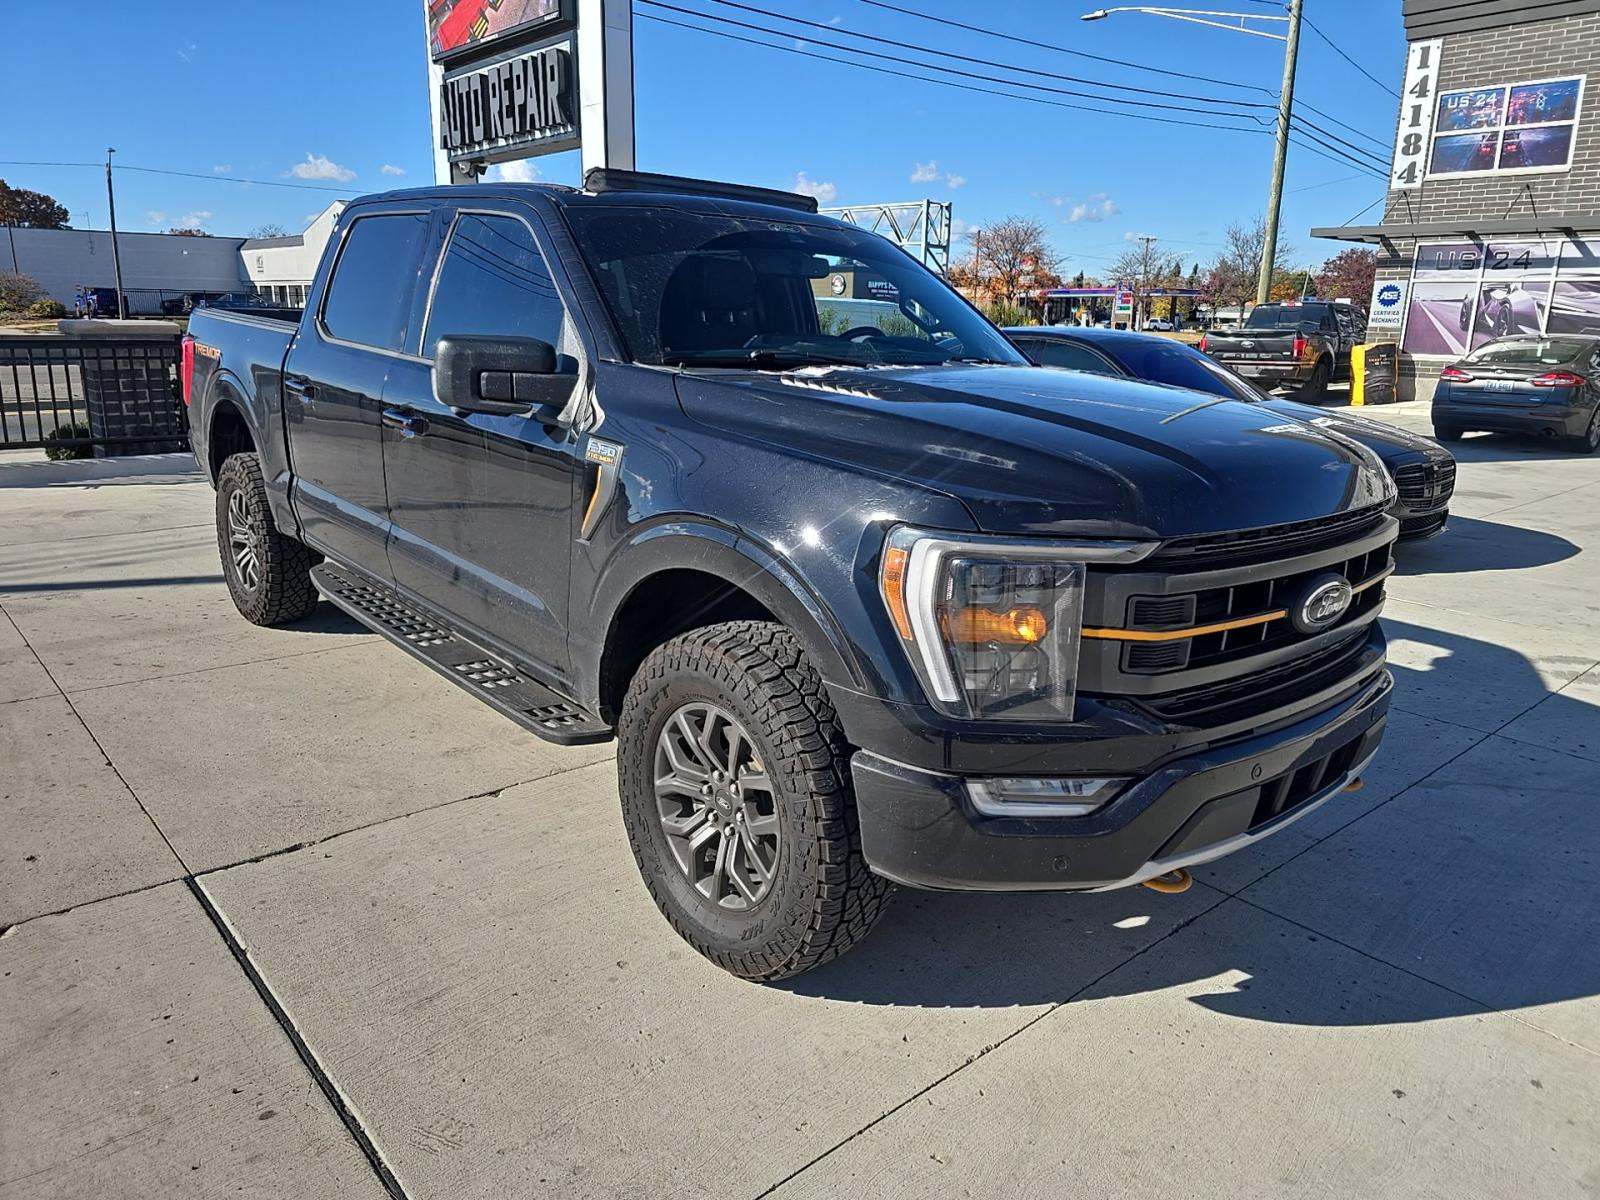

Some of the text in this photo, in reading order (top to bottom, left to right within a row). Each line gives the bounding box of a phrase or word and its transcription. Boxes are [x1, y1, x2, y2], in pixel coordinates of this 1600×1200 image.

[440, 48, 563, 150] AUTO REPAIR
[1396, 45, 1431, 185] 14184
[1447, 93, 1498, 109] US 24
[1435, 250, 1533, 271] US 24
